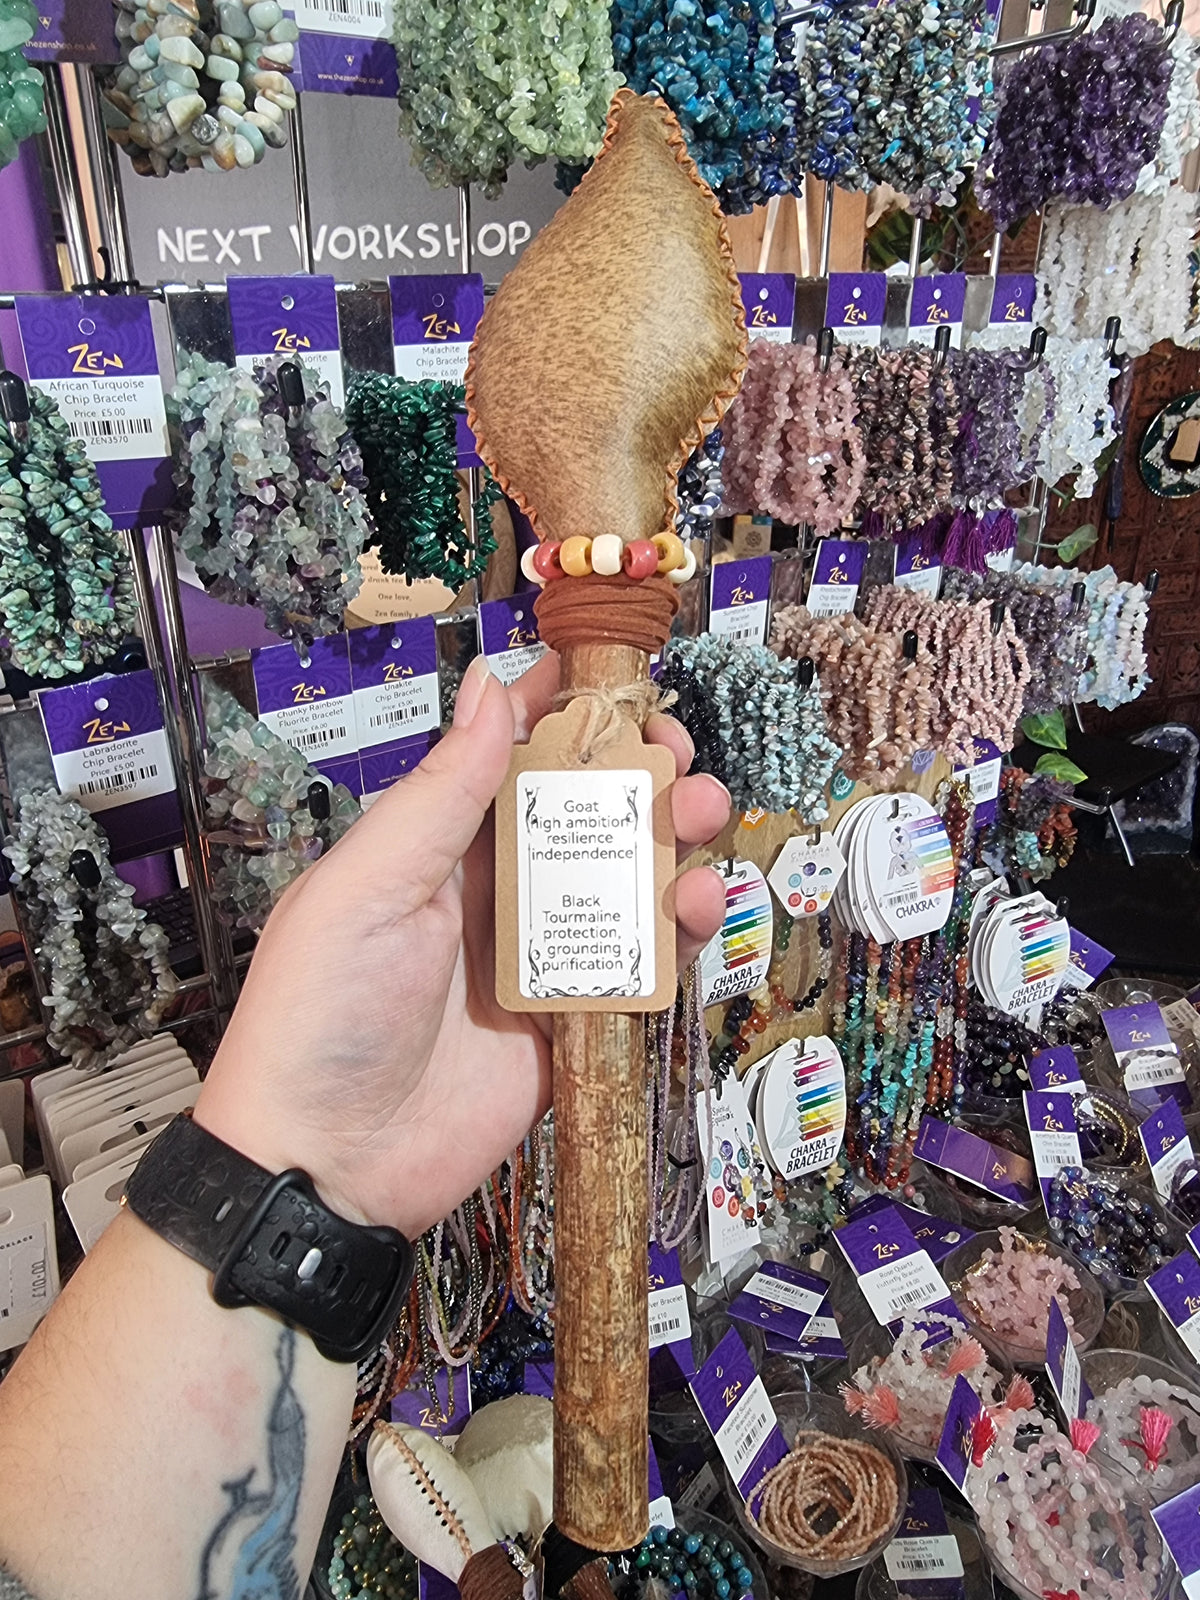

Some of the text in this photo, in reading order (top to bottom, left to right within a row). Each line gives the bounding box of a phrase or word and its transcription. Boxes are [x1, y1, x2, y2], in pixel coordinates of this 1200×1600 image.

[157, 225, 271, 265] NEXT
[751, 304, 777, 327] ZEN
[843, 303, 867, 325] ZEN
[926, 303, 949, 323] ZEN
[1004, 301, 1025, 321] ZEN
[422, 313, 461, 340] ZEN
[271, 327, 311, 353] ZEN
[422, 345, 460, 354] Malachite
[67, 343, 124, 375] ZEN
[415, 358, 434, 368] Chip
[49, 379, 145, 392] African Turquoise
[64, 393, 138, 406] Chip Bracelet
[90, 435, 129, 446] ZEN3570
[911, 554, 930, 570] ZEN
[828, 567, 848, 584] ZEN
[731, 586, 754, 605] ZEN
[390, 610, 412, 618] family
[507, 626, 537, 648] ZEN
[498, 652, 513, 662] Blue
[501, 661, 517, 671] Chip
[383, 663, 414, 682] ZEN
[291, 682, 327, 703] ZEN
[384, 679, 413, 692] Unakite
[375, 686, 423, 704] Chip Bracelet
[276, 699, 344, 720] Chunky Rainbow
[278, 707, 344, 729] Fluorite Bracelet
[82, 718, 131, 743] ZEN
[82, 739, 138, 758] Labradorite
[82, 747, 145, 769] Chip Bracelet
[104, 782, 137, 796] ZEN3597
[563, 799, 599, 813] Goat
[547, 832, 613, 844] resilience
[531, 847, 634, 863] independence
[562, 894, 601, 908] Black
[896, 898, 935, 919] CHAKRA
[542, 910, 621, 923] Tourmaline
[543, 926, 622, 942] protection,
[547, 942, 621, 958] grounding
[541, 957, 623, 975] purification
[713, 966, 753, 990] CHAKRA
[705, 973, 762, 1005] BRACELET
[1007, 984, 1055, 1011] BRACELET
[1012, 980, 1047, 999] CHAKRA
[1045, 1070, 1067, 1085] ZEN
[1043, 1114, 1064, 1131] ZEN
[790, 1137, 828, 1160] CHAKRA
[786, 1144, 837, 1174] BRACELET
[872, 1243, 900, 1260] ZEN
[648, 1274, 665, 1290] EN
[660, 1294, 683, 1306] Bracelet
[722, 1381, 742, 1408] ZEN
[904, 1516, 929, 1531] ZEN
